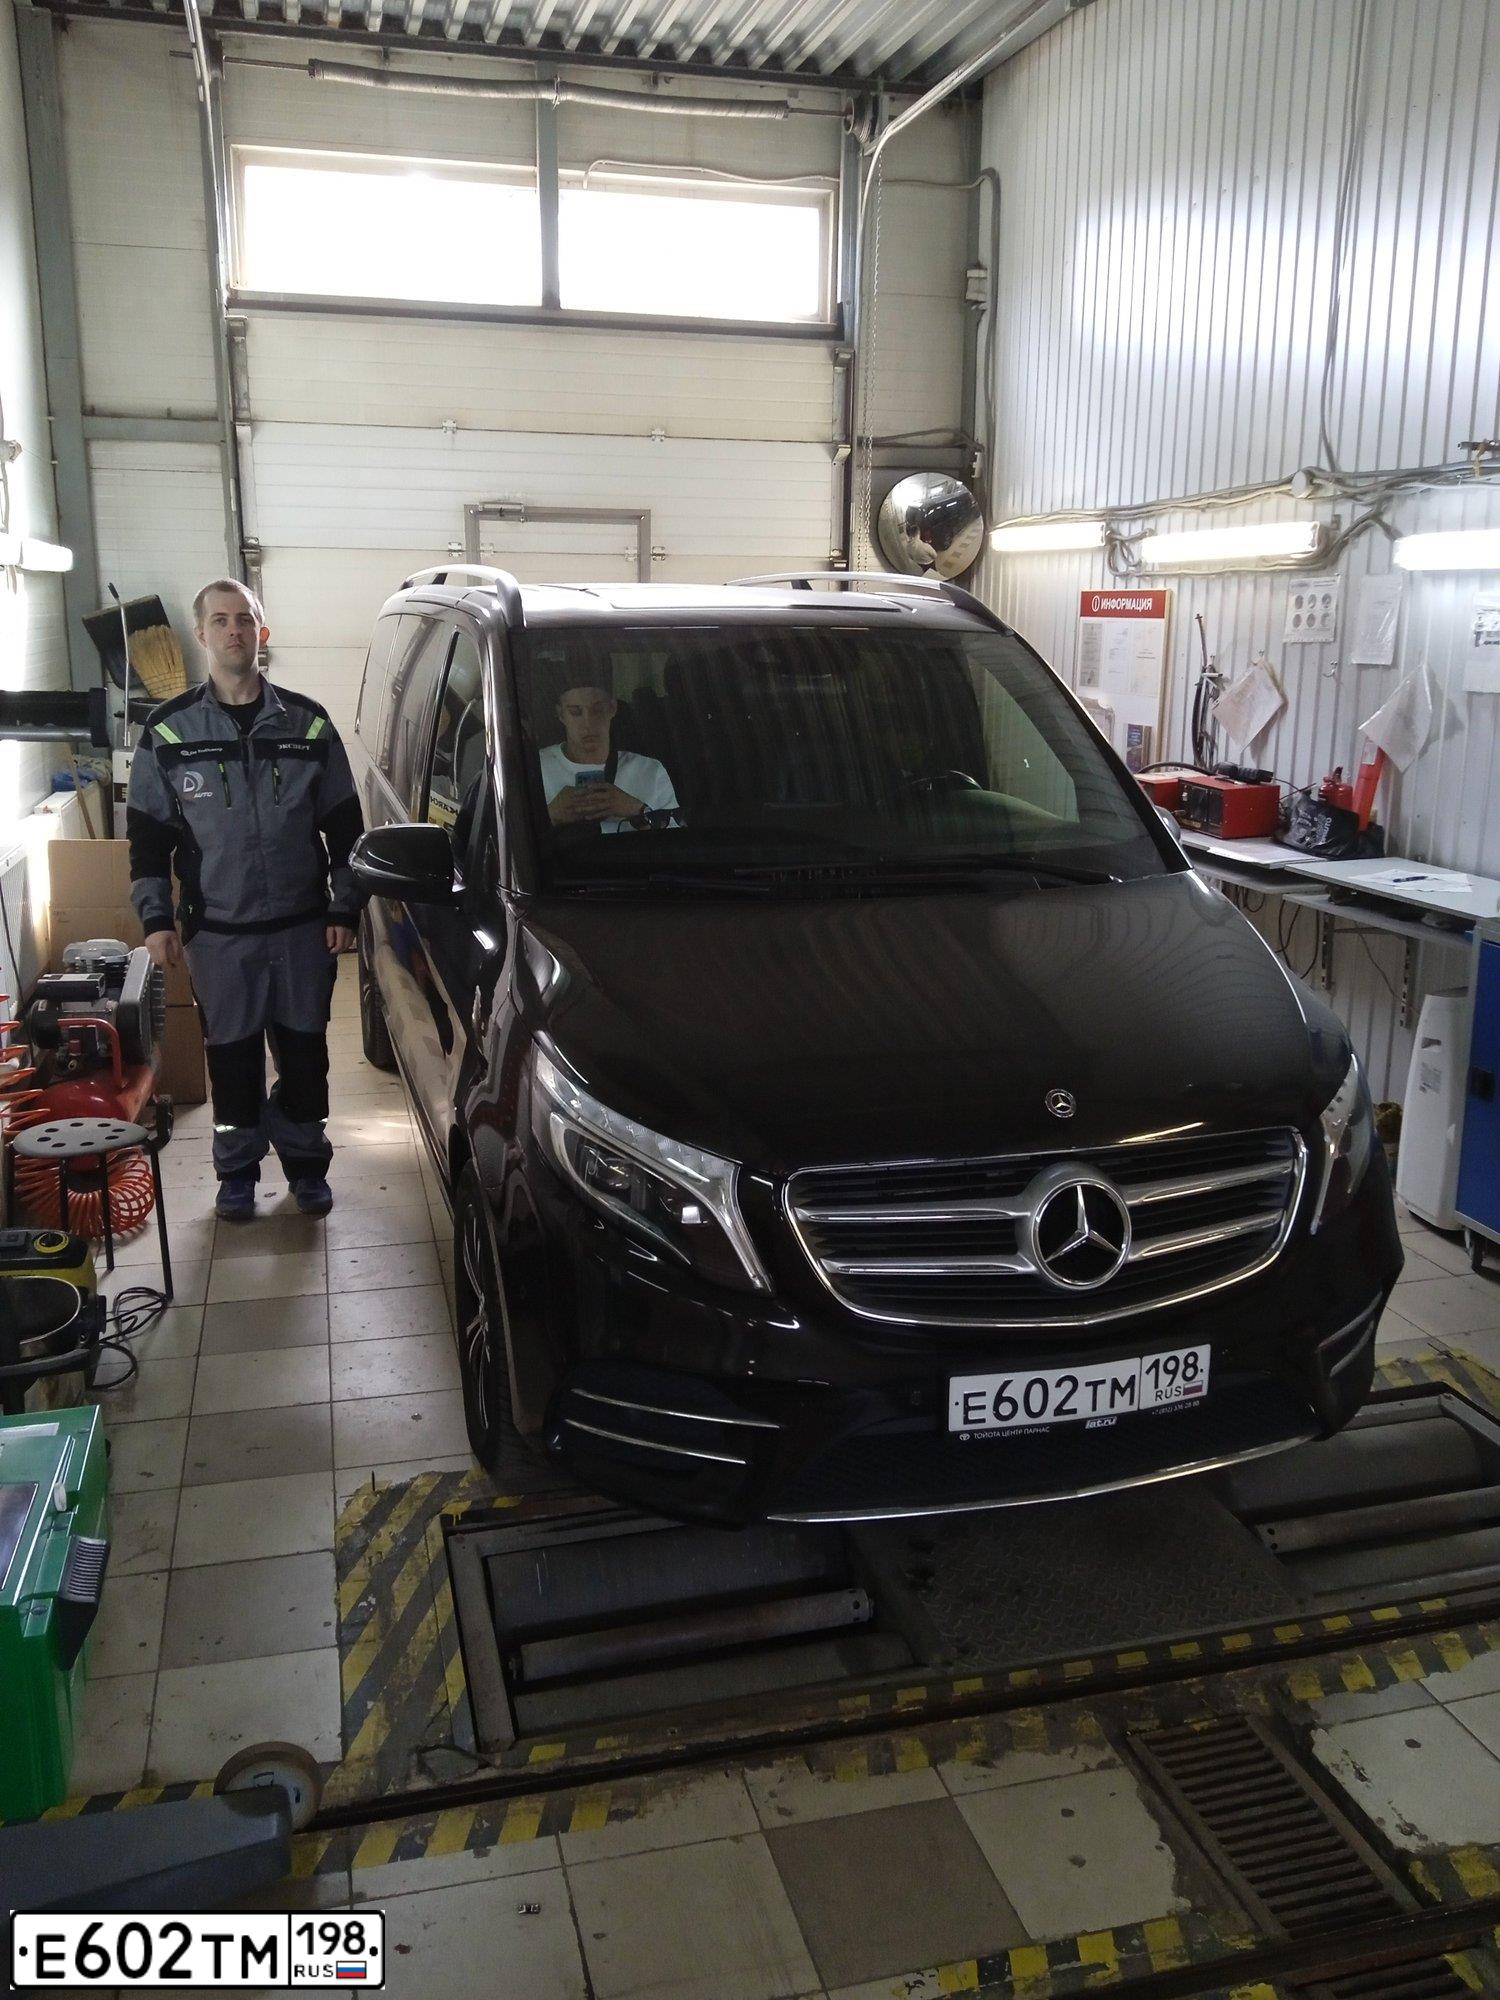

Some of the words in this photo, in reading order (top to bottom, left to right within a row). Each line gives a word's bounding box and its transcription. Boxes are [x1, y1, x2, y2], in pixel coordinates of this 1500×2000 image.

[1100, 597, 1152, 612] ИНФОРМАЦИЯ
[963, 1373, 1136, 1425] Е602ТМ
[1145, 1351, 1200, 1390] 198
[1155, 1386, 1182, 1401] RUS
[974, 1432, 1000, 1440] ТОЙОТА
[1001, 1429, 1023, 1438] ЦЕНТР
[1024, 1426, 1050, 1435] ПАРНАС
